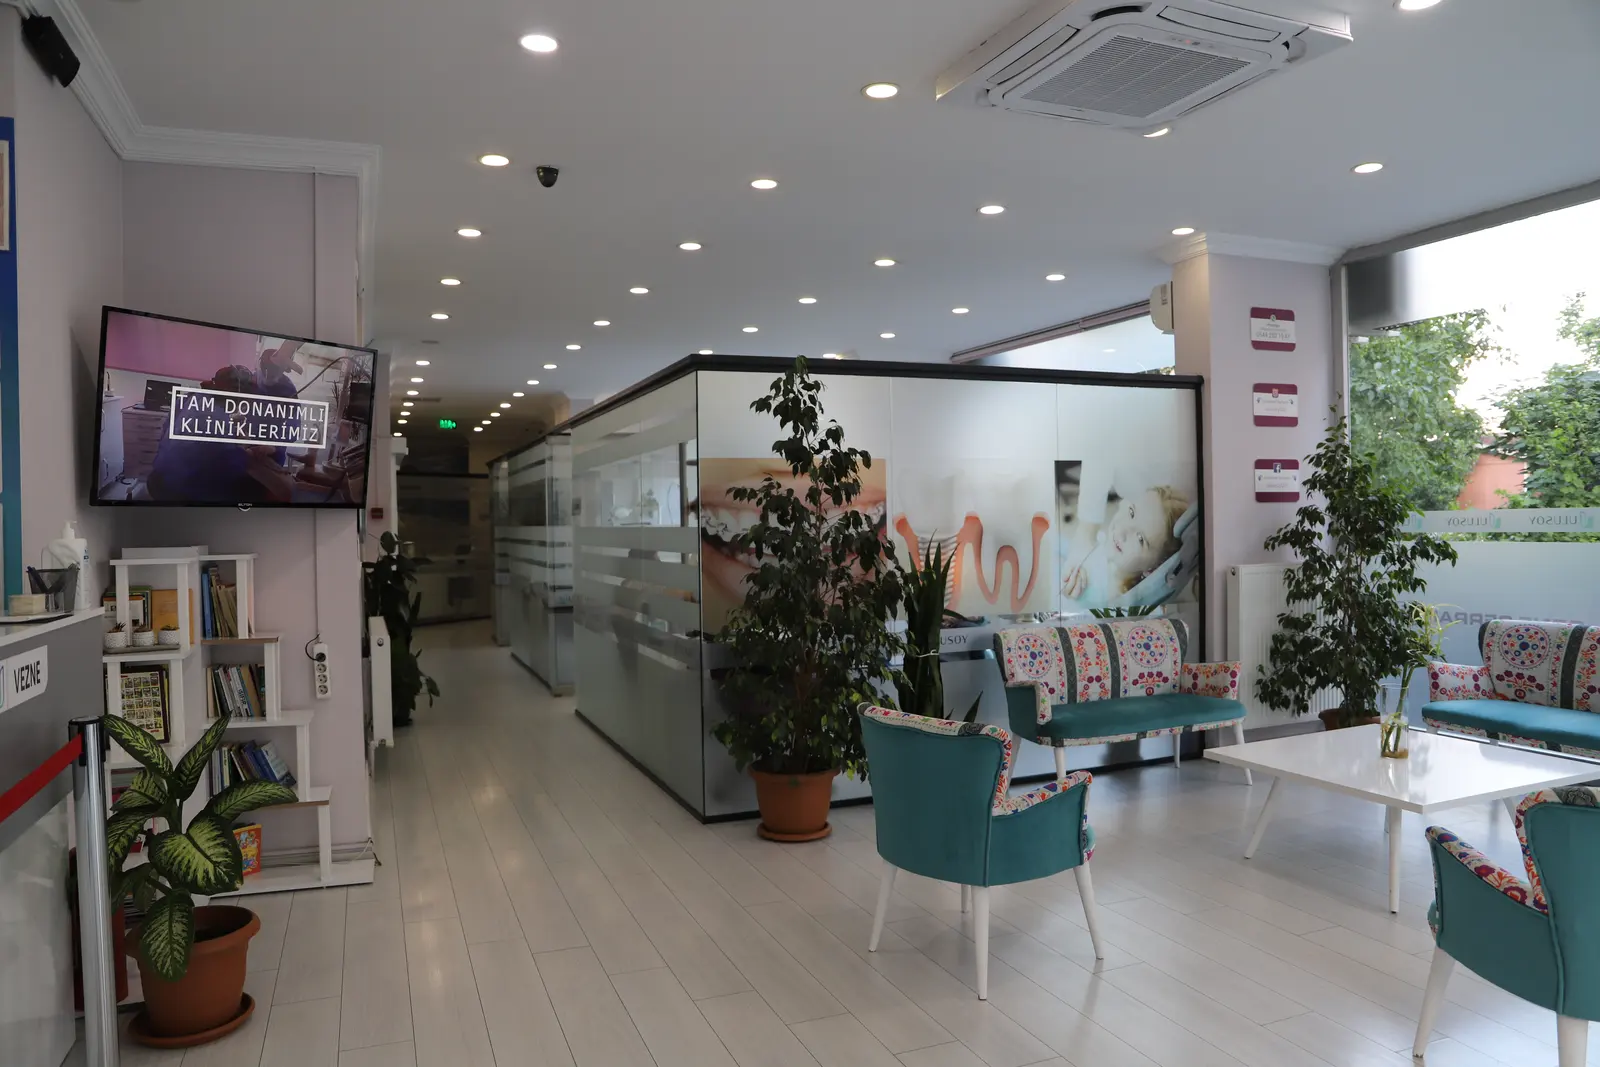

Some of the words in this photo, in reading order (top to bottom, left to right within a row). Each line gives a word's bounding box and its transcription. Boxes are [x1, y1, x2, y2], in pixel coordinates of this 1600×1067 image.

[176, 393, 215, 413] TAM
[225, 398, 324, 422] DONANIMLI
[181, 415, 318, 442] KLİNİKLERİMİZ
[940, 634, 968, 646] USOY
[13, 660, 41, 694] VEZNE
